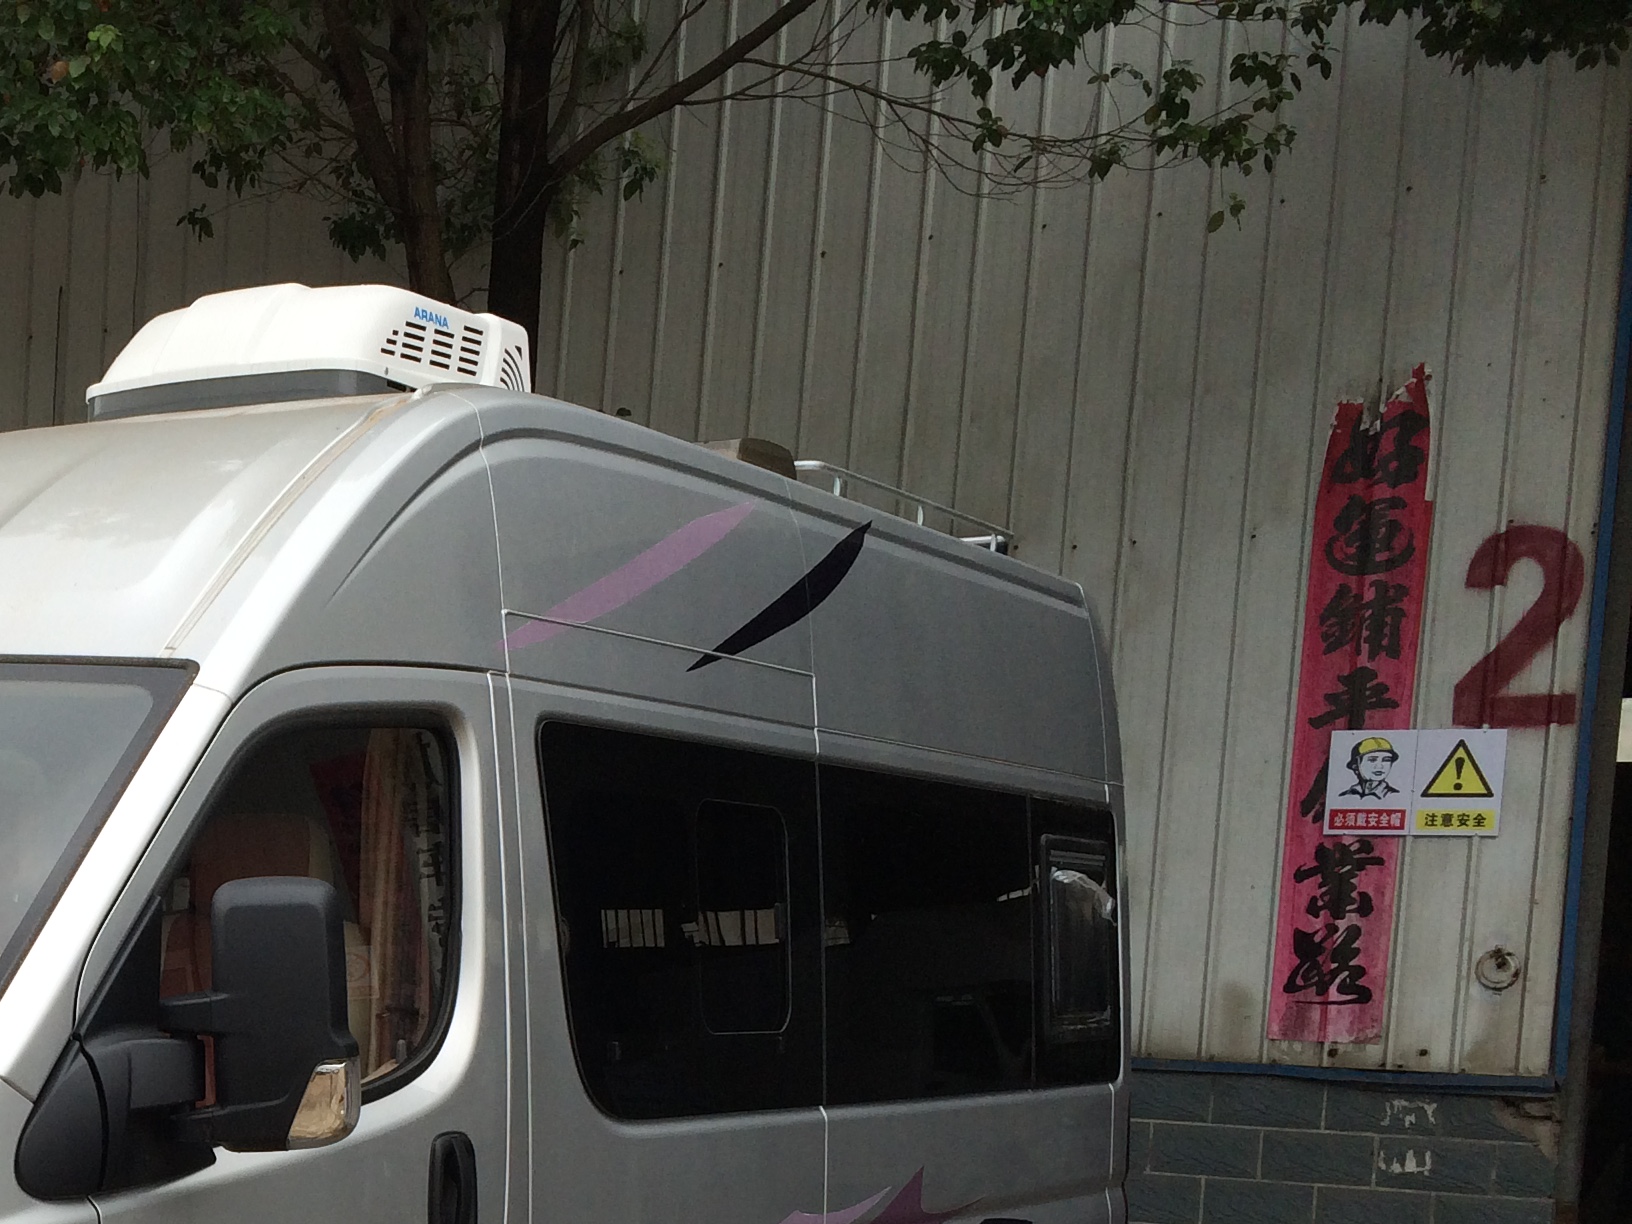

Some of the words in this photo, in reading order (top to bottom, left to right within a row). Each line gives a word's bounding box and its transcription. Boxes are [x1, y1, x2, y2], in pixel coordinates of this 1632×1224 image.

[414, 307, 449, 329] ARANA
[1452, 523, 1585, 728] 2
[1283, 408, 1430, 1005] 好運鋪平業路
[1424, 813, 1487, 828] 注意安全
